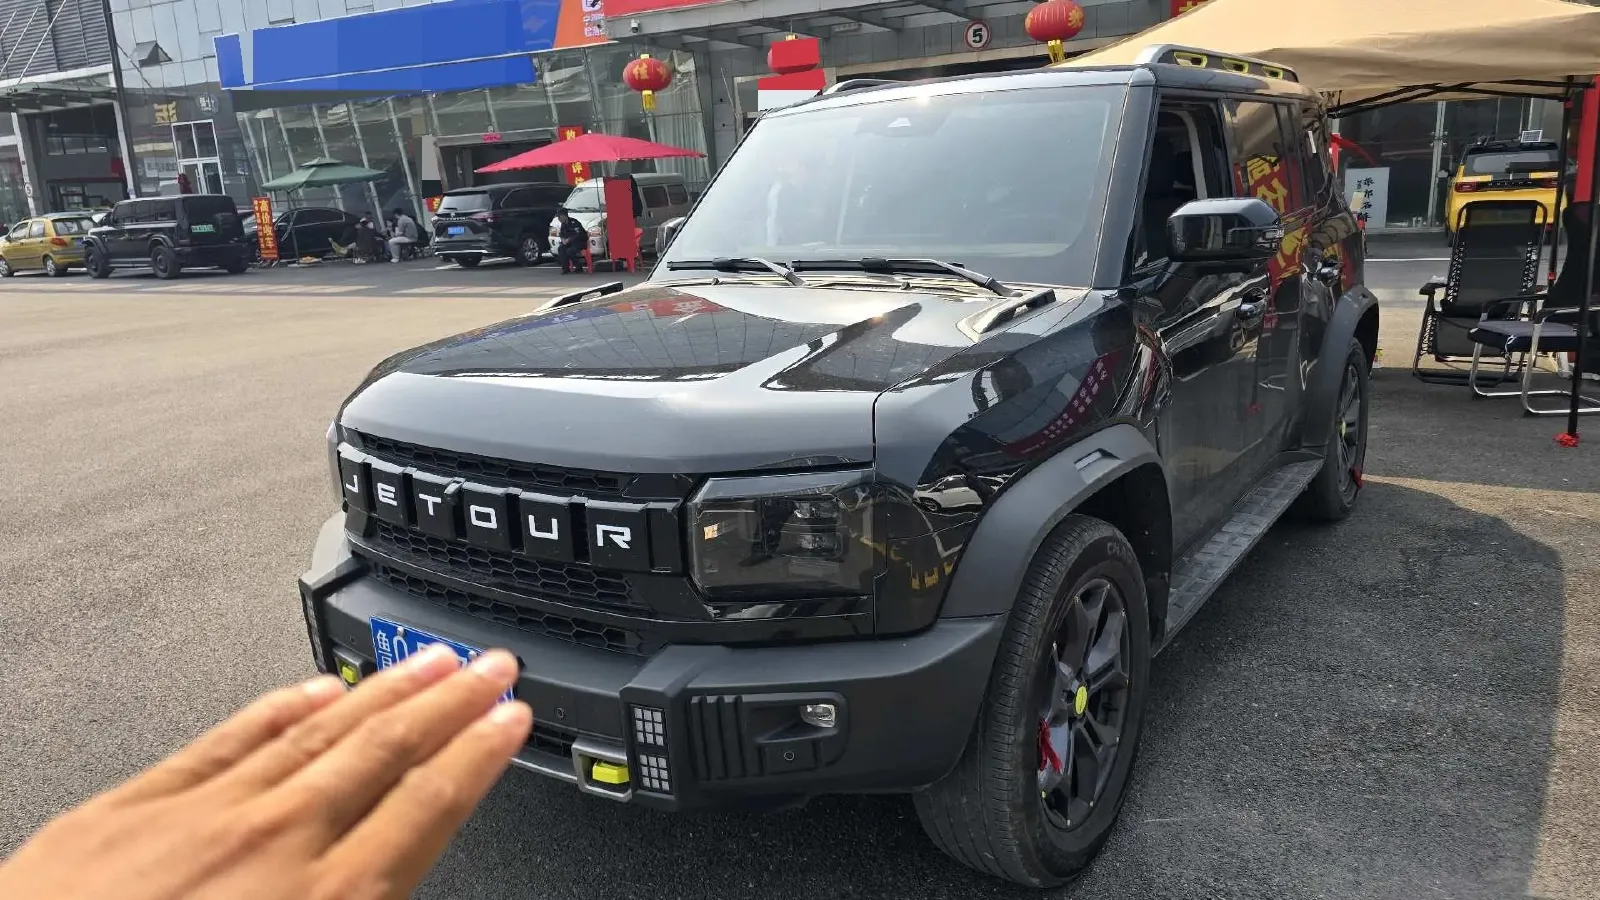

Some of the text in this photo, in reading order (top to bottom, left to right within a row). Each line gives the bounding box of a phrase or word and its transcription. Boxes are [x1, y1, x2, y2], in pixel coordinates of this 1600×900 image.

[972, 27, 983, 44] 5
[258, 199, 274, 249] 高价收车
[345, 474, 631, 550] JETOUR
